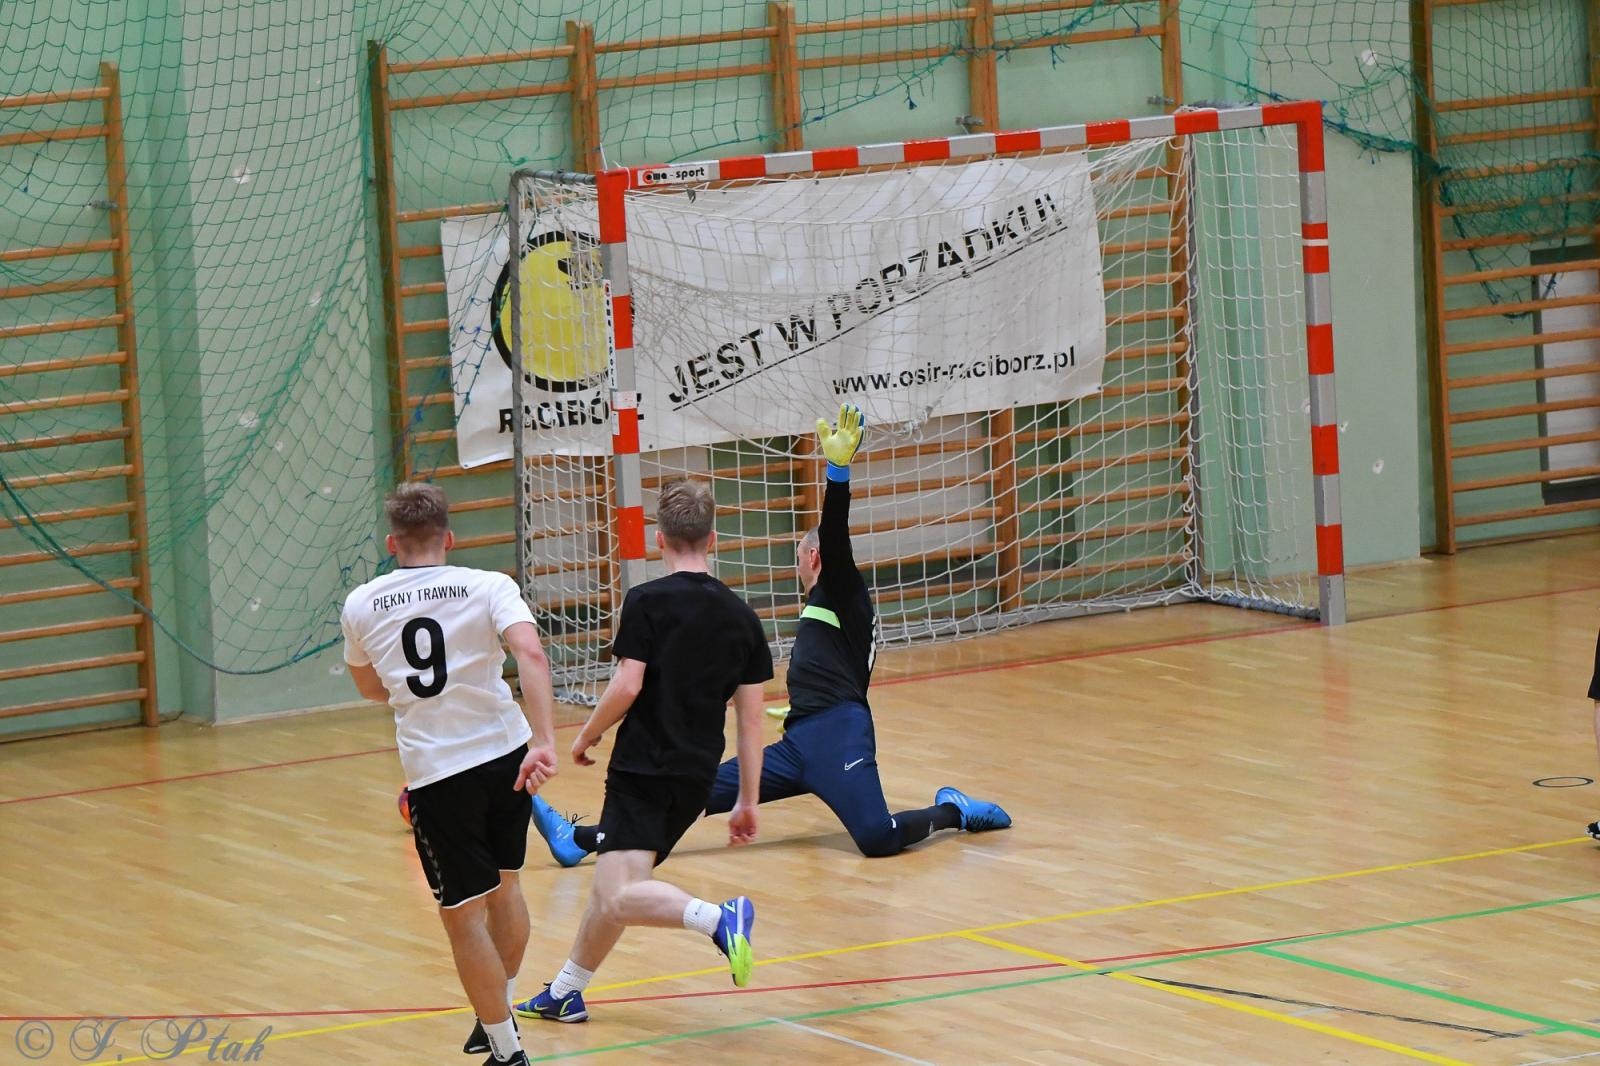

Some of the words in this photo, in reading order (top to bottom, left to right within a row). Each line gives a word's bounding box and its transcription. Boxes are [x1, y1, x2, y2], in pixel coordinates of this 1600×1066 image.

[676, 167, 705, 181] sport
[668, 328, 764, 403] JEST
[832, 345, 1076, 395] www.osir-raciborz.pl
[498, 390, 645, 434] RACIBÓ
[373, 591, 412, 612] PIĘKNY
[416, 585, 469, 602] TRAWNIK
[401, 616, 448, 698] 9
